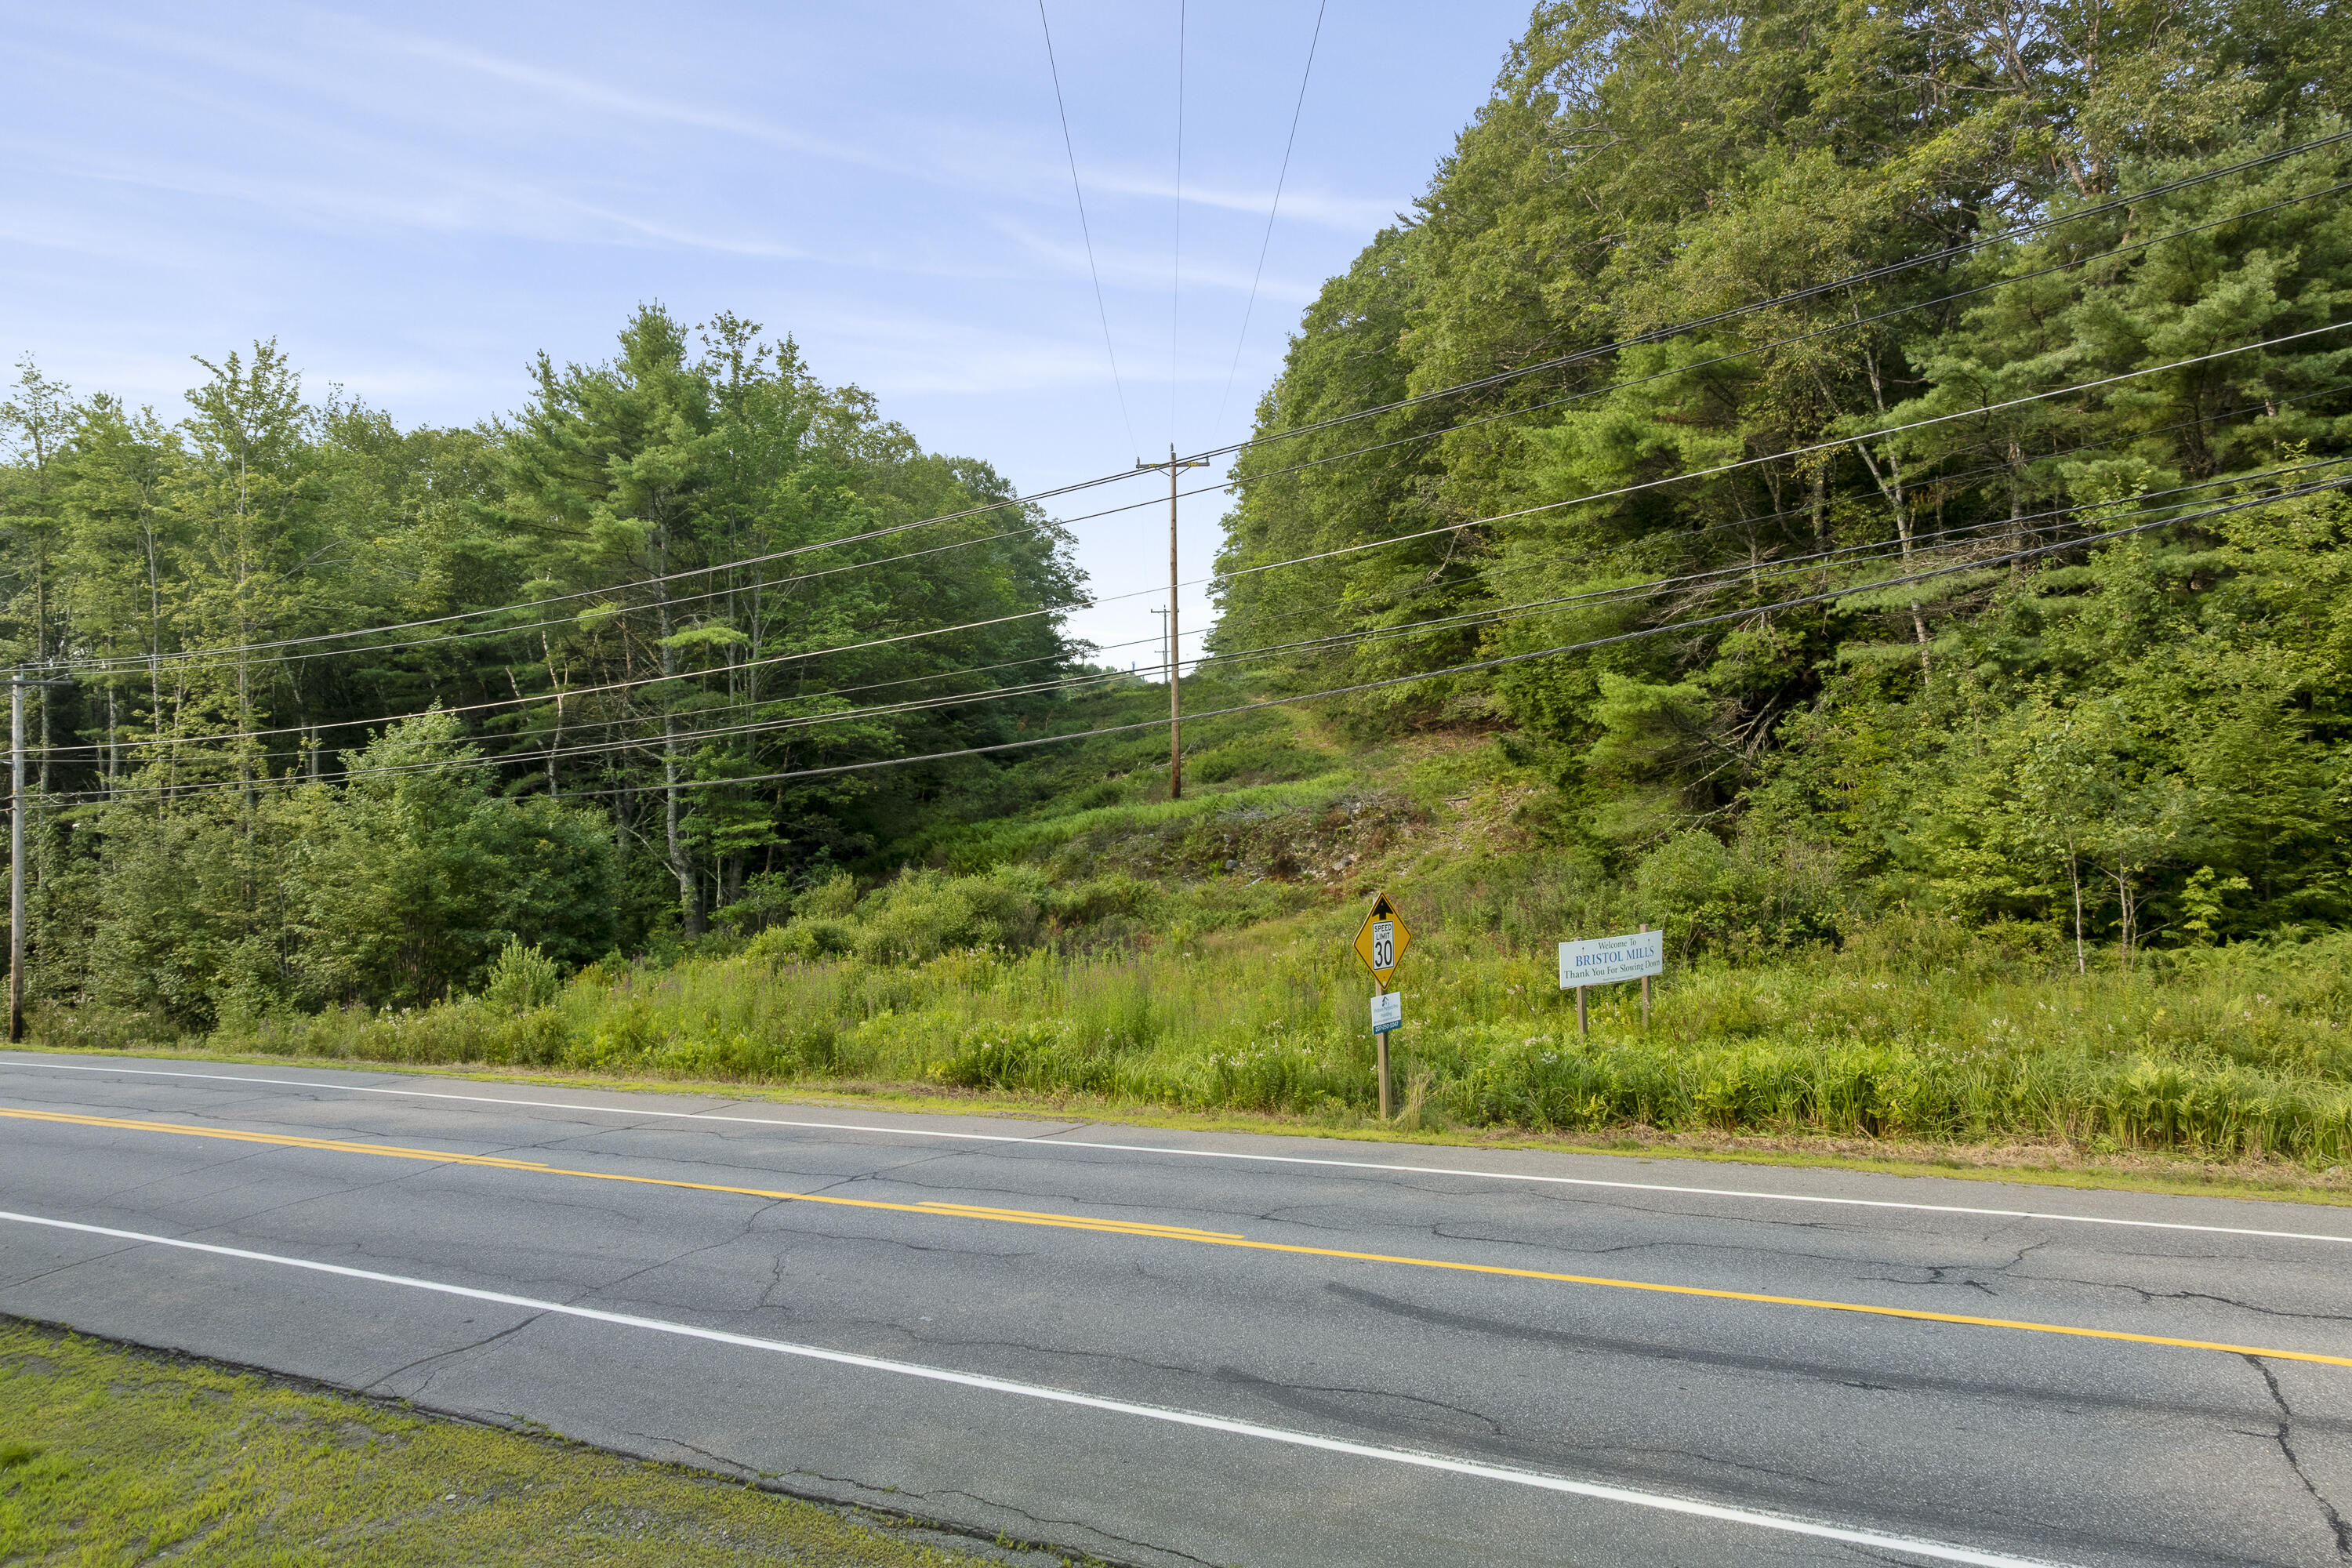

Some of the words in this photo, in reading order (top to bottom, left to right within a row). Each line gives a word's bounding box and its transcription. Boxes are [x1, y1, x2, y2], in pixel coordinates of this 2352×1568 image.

[1374, 924, 1392, 933] SPEED
[1598, 940, 1628, 949] Welcome
[1629, 938, 1637, 946] To
[1374, 940, 1392, 967] 30
[1576, 950, 1624, 967] BRISTOL
[1626, 946, 1654, 960] MILLS
[1564, 969, 1590, 978] Thank
[1592, 967, 1605, 977] You
[1607, 965, 1618, 975] For
[1619, 962, 1645, 972] Slowing
[1645, 960, 1661, 969] Down
